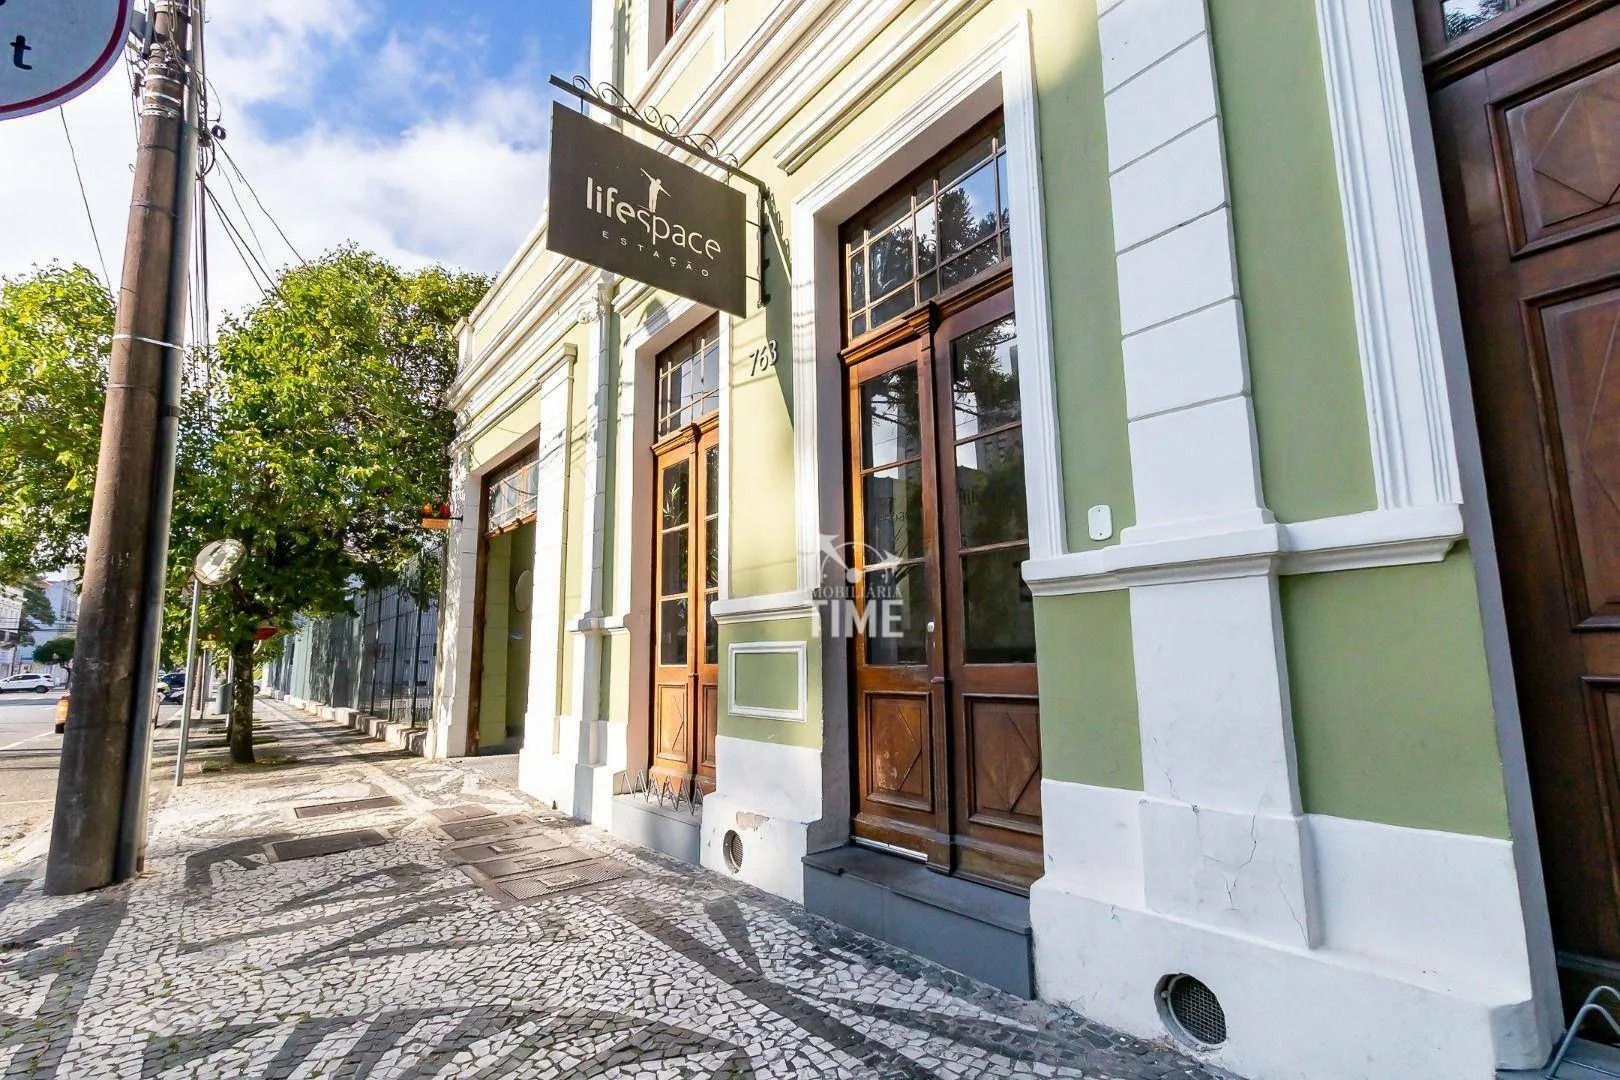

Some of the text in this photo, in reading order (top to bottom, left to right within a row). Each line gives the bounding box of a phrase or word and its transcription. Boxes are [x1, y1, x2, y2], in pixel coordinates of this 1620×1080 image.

[10, 35, 32, 70] t
[586, 176, 721, 260] lifespace
[602, 230, 709, 277] ESTAÇÃO
[749, 339, 779, 376] 763
